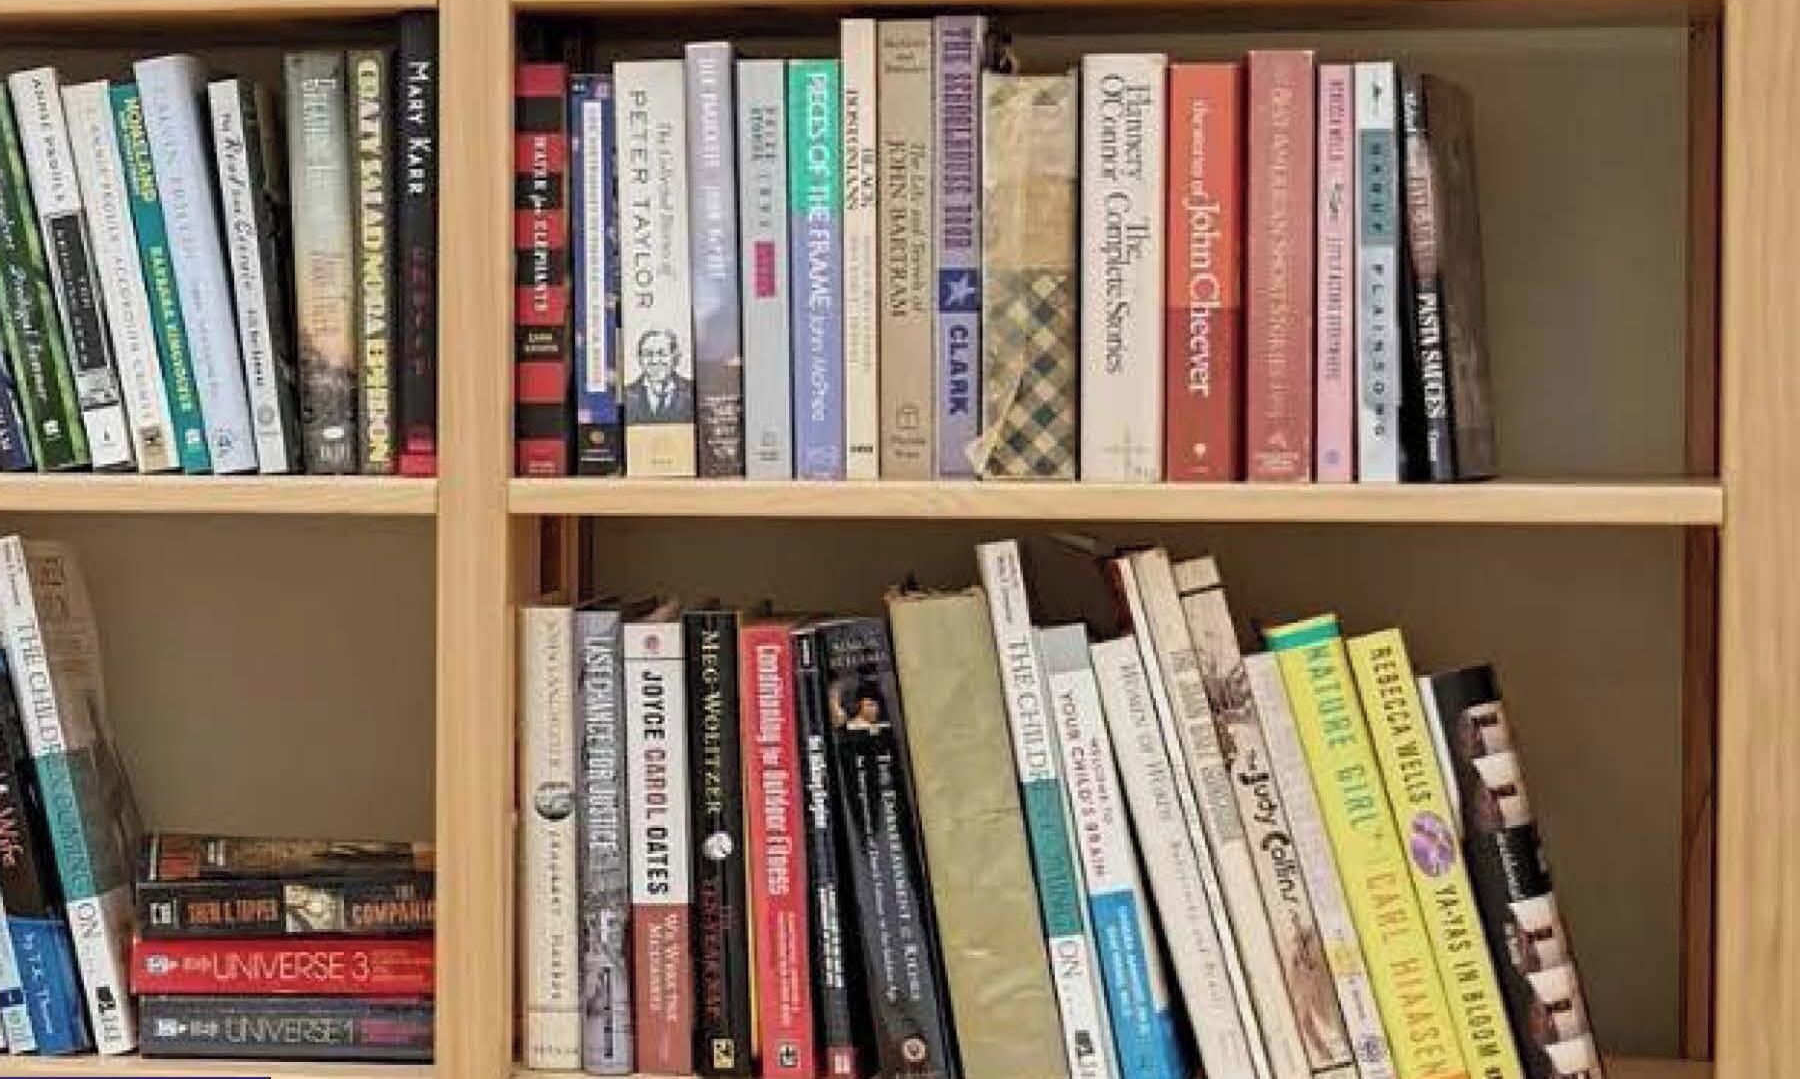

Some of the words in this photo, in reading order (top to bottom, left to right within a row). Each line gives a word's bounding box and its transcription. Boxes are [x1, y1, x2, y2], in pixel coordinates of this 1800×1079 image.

[942, 27, 971, 64] THE
[628, 90, 649, 186] PETER
[807, 72, 830, 138] PIECES
[1123, 83, 1151, 182] Flannery
[531, 136, 550, 191] WATER
[807, 142, 830, 180] OF
[884, 139, 908, 203] JOHN
[909, 142, 926, 170] The
[1369, 142, 1384, 235] HARUF
[807, 184, 830, 226] THE
[909, 208, 924, 236] and
[1181, 197, 1222, 269] John
[532, 220, 550, 312] ELEPHANTS
[631, 199, 654, 310] TAYLOR
[660, 261, 677, 277] of
[807, 228, 832, 311] FRAME
[887, 207, 908, 319] BARTRAM
[1100, 191, 1129, 300] Complete
[1126, 218, 1150, 261] The
[909, 296, 926, 312] of
[1104, 300, 1130, 376] Stories
[1188, 272, 1222, 398] Cheever
[1416, 292, 1440, 347] PASTA
[948, 323, 970, 417] CLARK
[1370, 263, 1387, 437] PLAINSONG
[1423, 349, 1446, 420] SAUCES
[13, 621, 41, 669] THE
[584, 635, 615, 673] LAST
[700, 630, 722, 684] MEG
[1007, 640, 1034, 690] THE
[584, 675, 615, 744] CHANCE
[641, 670, 665, 740] JOYCE
[756, 644, 784, 745] Conditioning
[1059, 688, 1083, 740] YOUR
[1370, 645, 1408, 737] REBECCA
[584, 745, 615, 782] FOR
[645, 747, 666, 820] CAROL
[702, 691, 725, 815] WOLITZER
[1069, 745, 1098, 819] CHILD'S
[1392, 741, 1434, 807] WELLS
[586, 784, 617, 852] JUSTICE
[761, 769, 790, 836] Outdoor
[1239, 769, 1289, 827] Judy
[1306, 645, 1358, 750] NATURE
[1336, 765, 1377, 830] GIRL
[1364, 871, 1403, 943] CARL
[647, 826, 669, 896] OATES
[765, 835, 794, 895] Fitness
[1262, 830, 1300, 902] Collins
[1434, 884, 1473, 954] YA-YAS
[212, 951, 346, 980] UNIVERSE
[351, 951, 369, 980] 3
[1454, 960, 1479, 984] IN
[1461, 991, 1500, 1058] BLOOM
